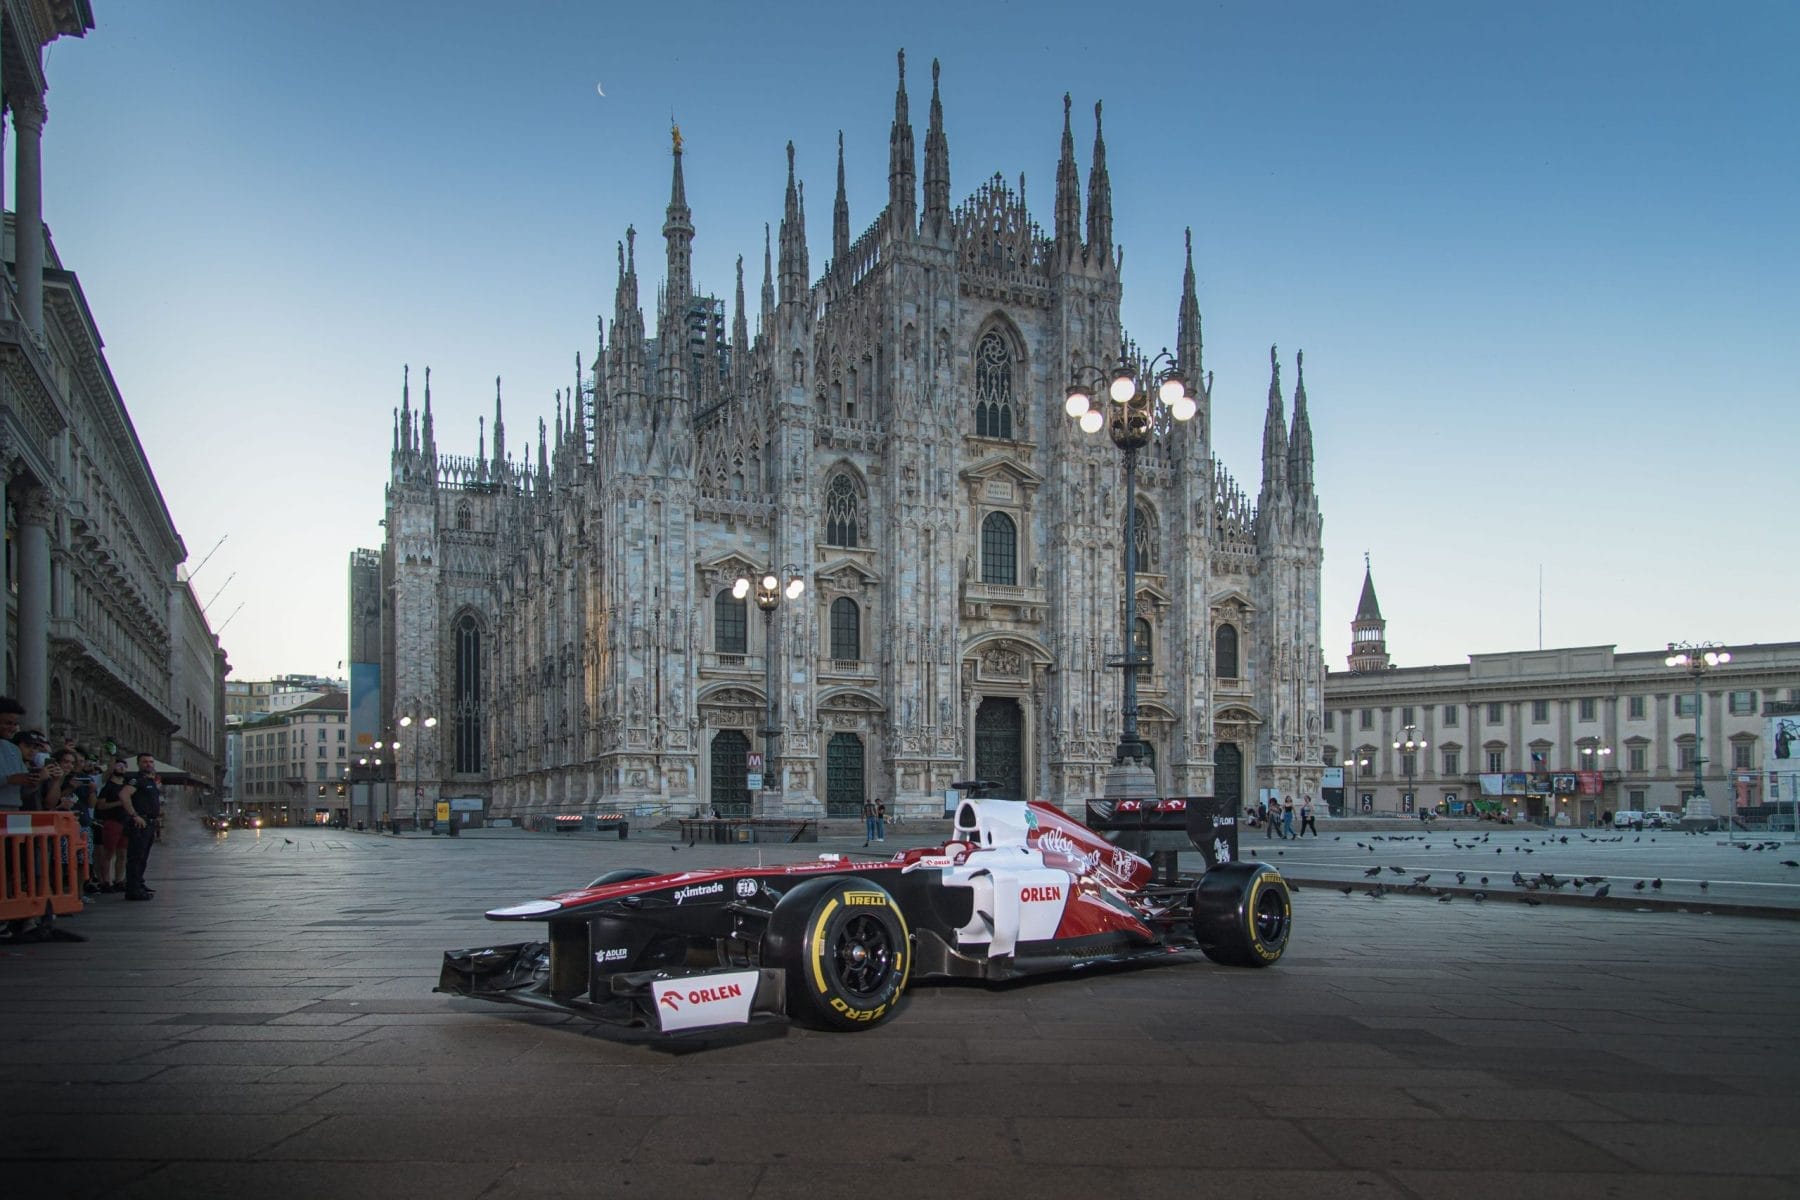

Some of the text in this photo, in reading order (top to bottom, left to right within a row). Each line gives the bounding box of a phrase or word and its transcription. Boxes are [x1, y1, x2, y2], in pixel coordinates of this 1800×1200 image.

[749, 755, 761, 766] M
[674, 882, 724, 905] aximtrade
[843, 891, 886, 906] PIRELLI
[1020, 886, 1061, 903] ORLEN
[605, 948, 628, 957] ADLER
[688, 983, 742, 1005] ORLEN
[830, 997, 887, 1021] ZERO
